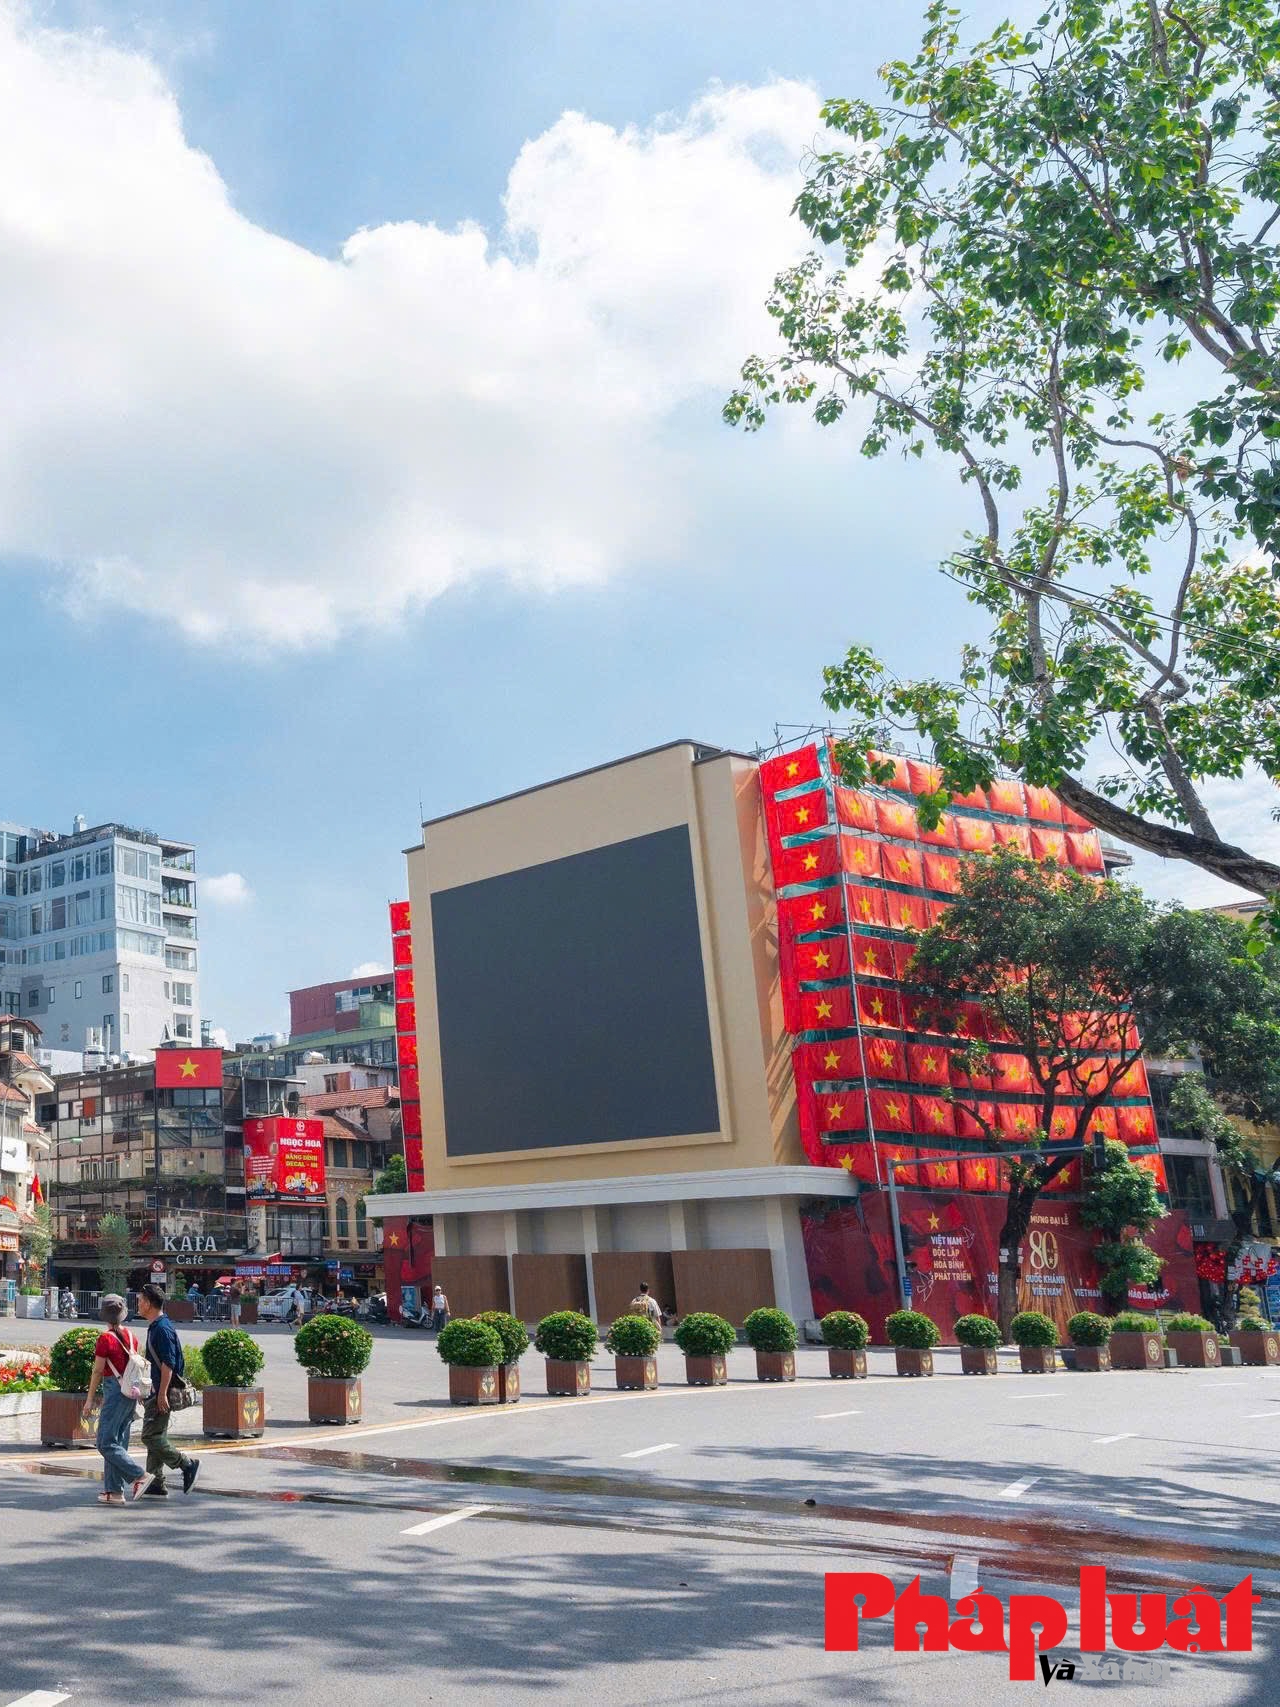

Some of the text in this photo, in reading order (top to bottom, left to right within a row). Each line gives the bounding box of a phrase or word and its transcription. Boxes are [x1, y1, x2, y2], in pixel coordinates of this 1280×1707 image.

[163, 1236, 217, 1252] KAFA
[931, 1234, 963, 1246] VIỆT NAM
[933, 1247, 946, 1258] ĐỘC
[1029, 1230, 1058, 1270] 80
[176, 1254, 204, 1265] Café
[934, 1270, 951, 1280] PHÁT
[1025, 1272, 1065, 1284] QUỐC KHÁNH
[1032, 1285, 1062, 1296] VIỆT NAM
